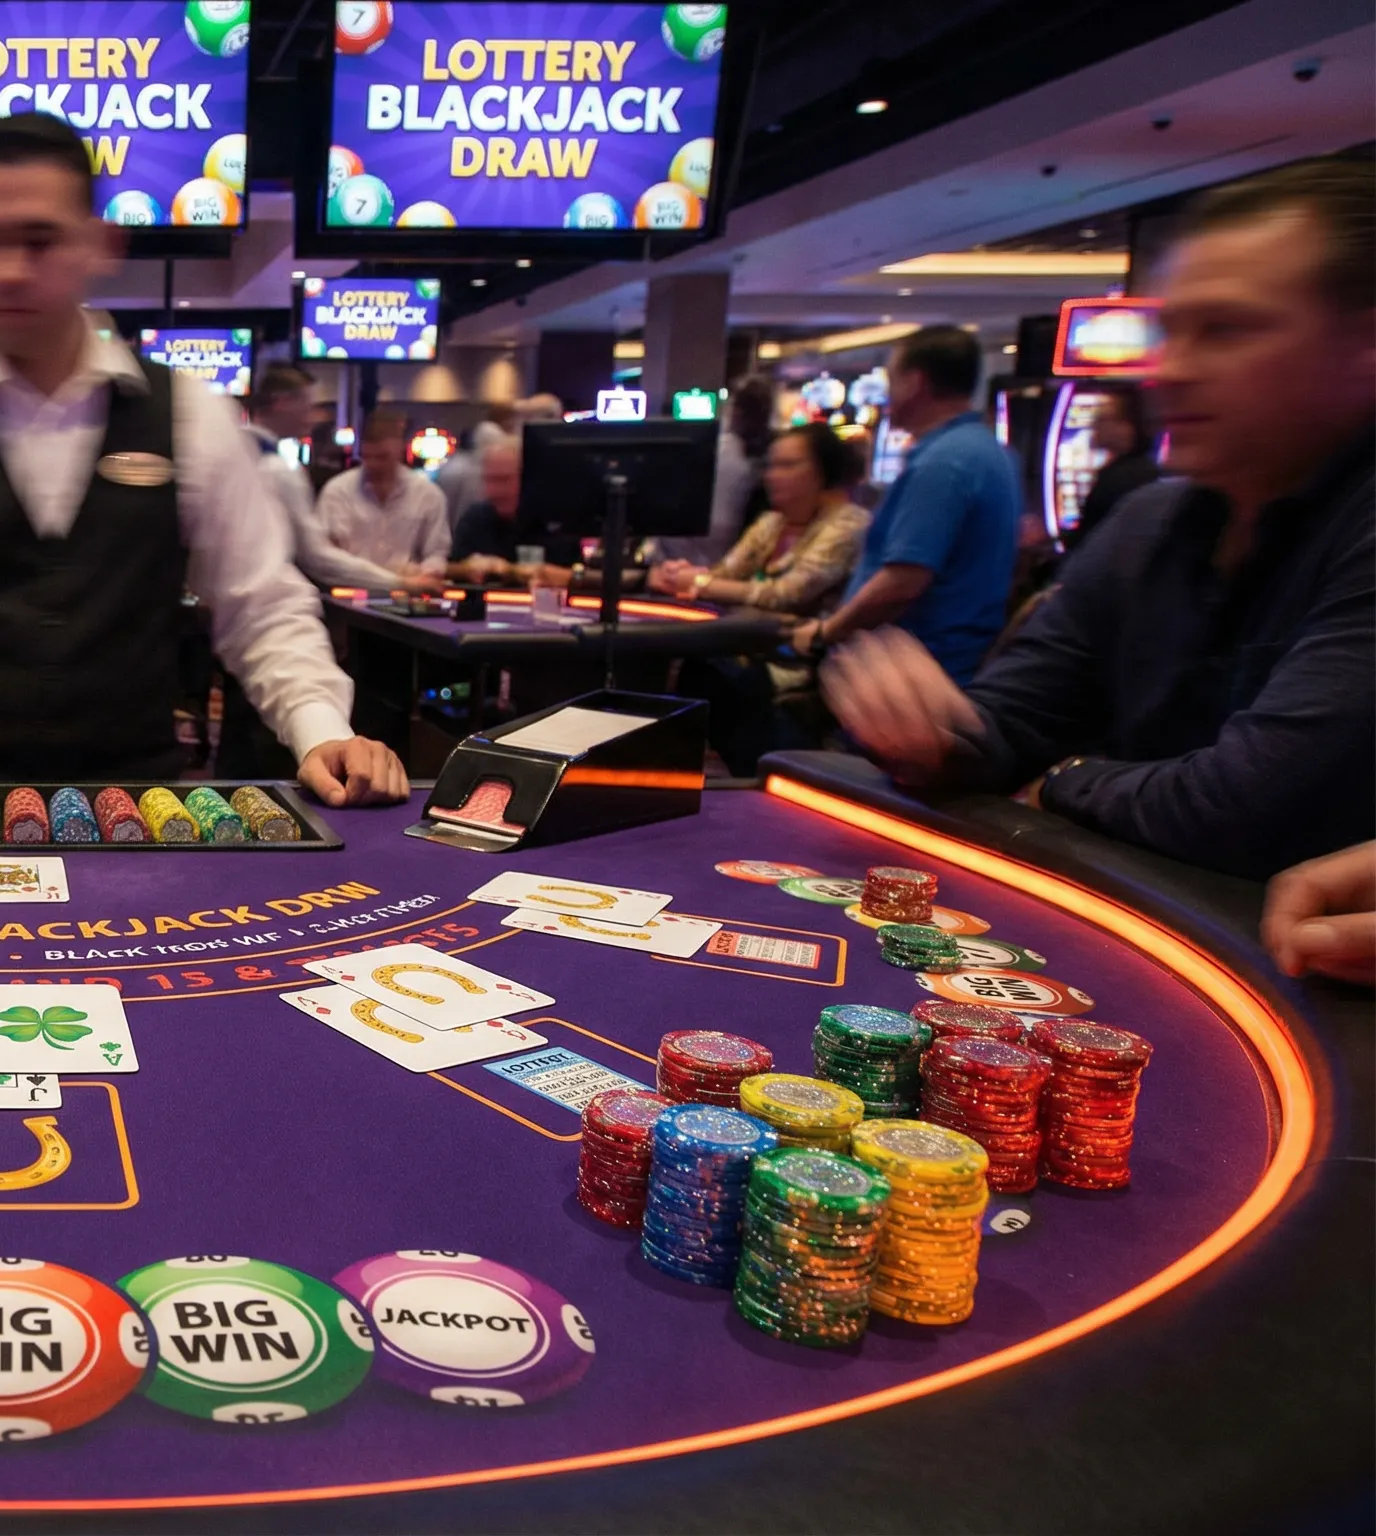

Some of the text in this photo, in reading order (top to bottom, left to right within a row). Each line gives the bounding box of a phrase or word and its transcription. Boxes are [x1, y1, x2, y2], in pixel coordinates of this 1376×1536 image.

[352, 8, 366, 26] 7
[423, 38, 636, 82] LOTTERY
[366, 84, 683, 133] BLACKJACK
[450, 136, 598, 178] DRAW
[355, 199, 367, 214] 7
[333, 290, 410, 307] LOTTERY
[316, 306, 427, 325] BLACKJACK
[344, 324, 398, 341] DRAW
[165, 339, 228, 353] LOTTERY
[265, 881, 381, 917] DRW
[44, 946, 149, 961] BLACK
[173, 1300, 279, 1330] BIG
[380, 1307, 531, 1335] JACKPOT
[171, 1331, 301, 1364] WIN
